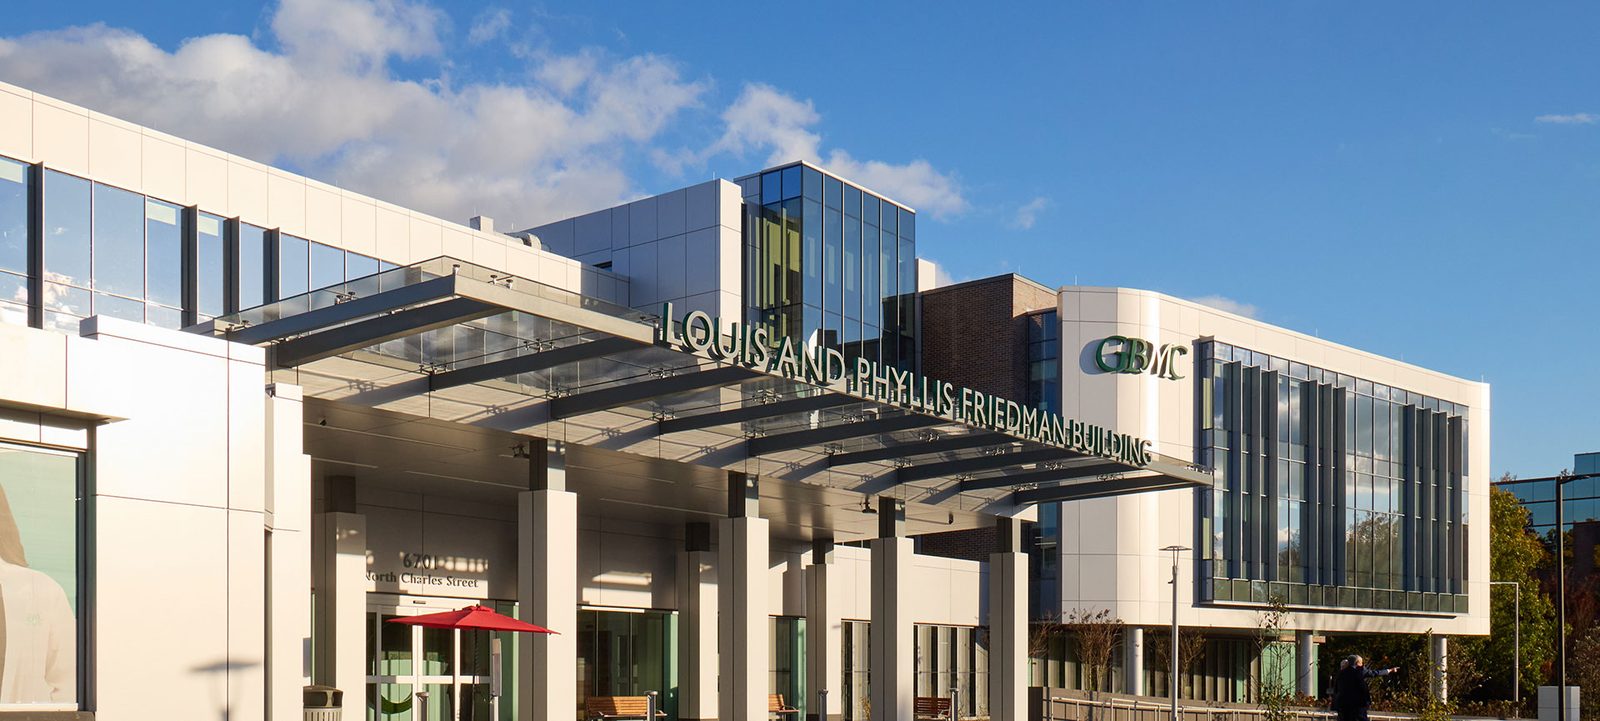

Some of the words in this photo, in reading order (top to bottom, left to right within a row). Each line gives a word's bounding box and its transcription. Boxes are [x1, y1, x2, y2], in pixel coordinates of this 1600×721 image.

[1095, 335, 1188, 380] GBMC
[662, 302, 769, 368] LOUIS
[773, 335, 846, 388] AND
[854, 356, 954, 416] PHYLLIS
[958, 386, 1067, 447] FRIEDMAN
[1069, 418, 1153, 466] BUILDING
[403, 552, 438, 570] 6701
[401, 572, 443, 586] Charles
[446, 575, 479, 588] Street
